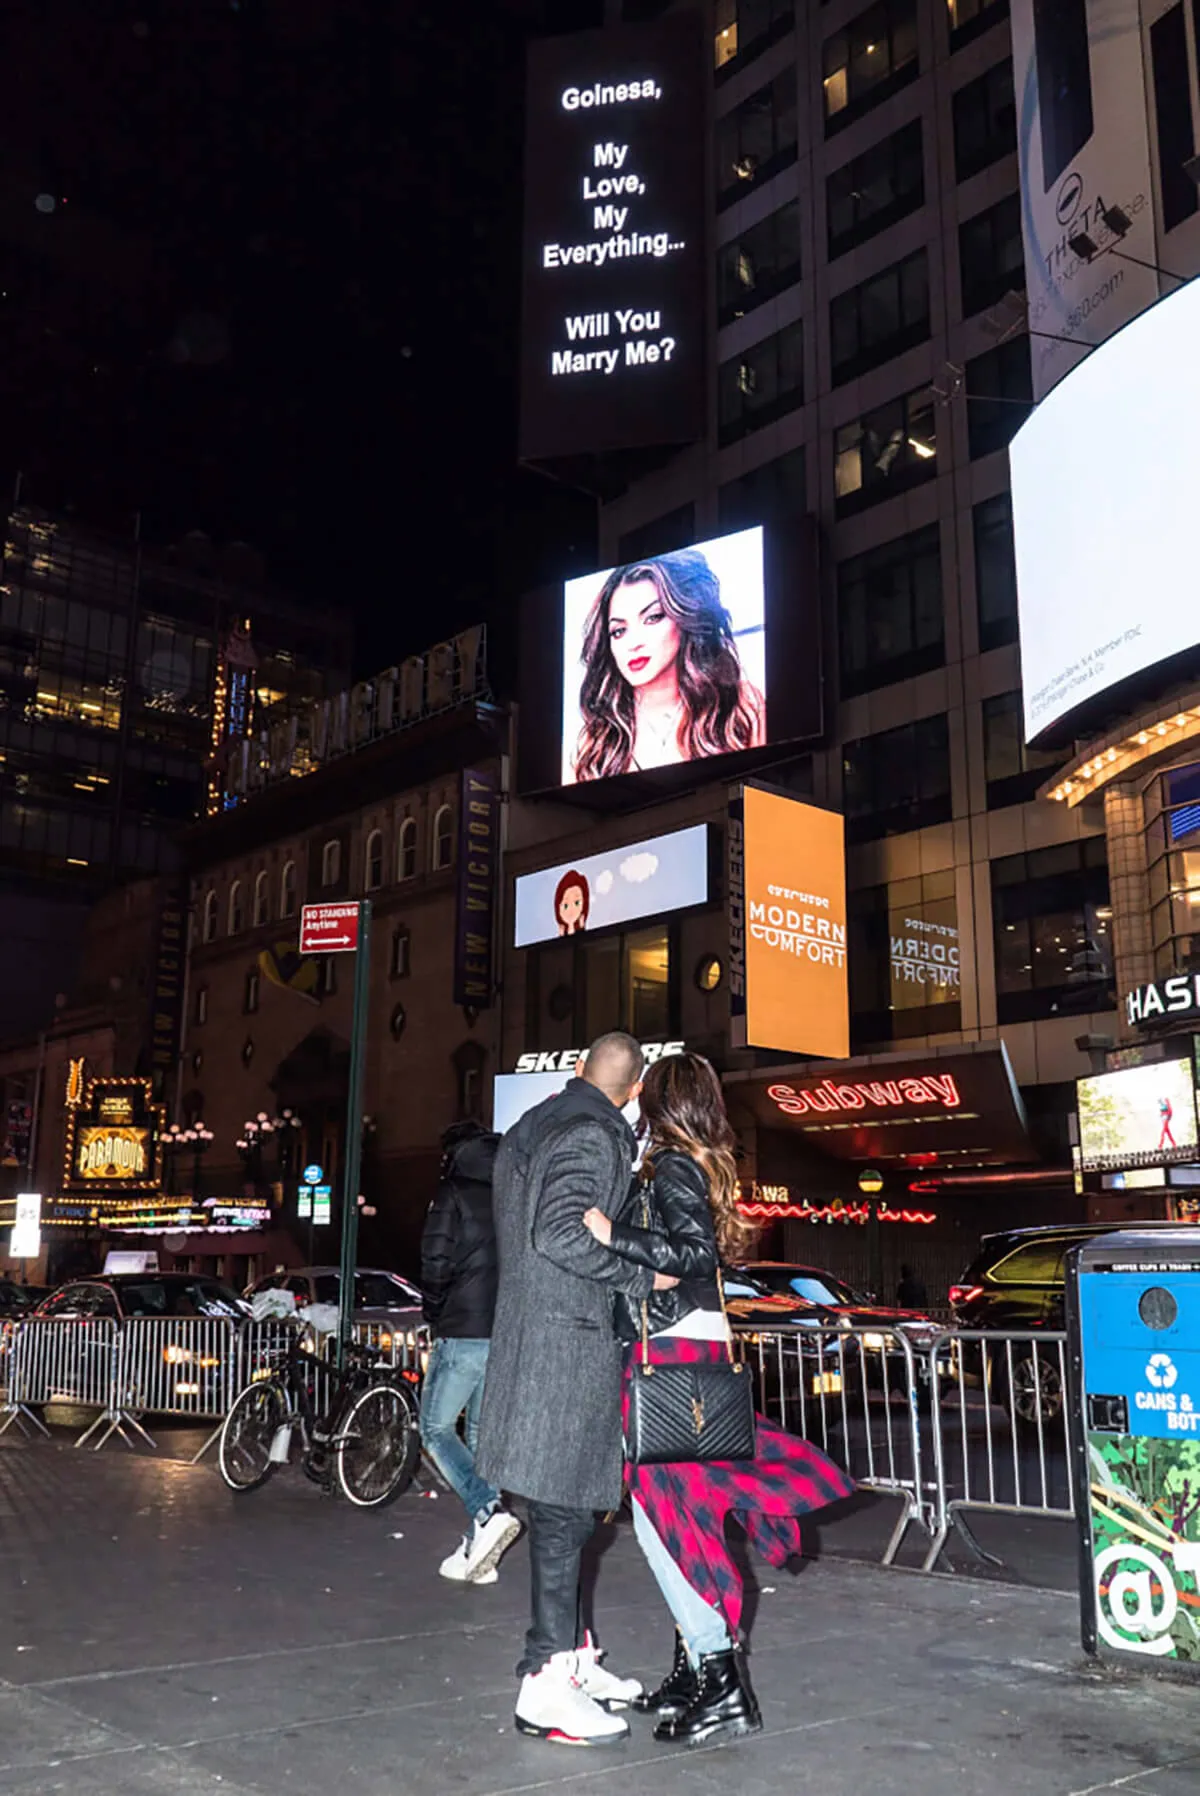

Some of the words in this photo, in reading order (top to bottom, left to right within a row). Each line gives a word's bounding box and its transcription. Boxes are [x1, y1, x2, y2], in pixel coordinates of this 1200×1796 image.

[594, 142, 628, 169] My
[583, 174, 646, 200] Love,
[594, 205, 628, 231] My
[543, 232, 685, 268] Everything...
[566, 312, 609, 340] Will
[615, 309, 660, 335] You
[552, 348, 617, 375] Marry
[625, 336, 675, 366] Me?
[465, 778, 491, 912] VICTORY
[306, 909, 318, 920] NO
[306, 920, 339, 932] Anytime
[750, 901, 845, 943] MODERN
[750, 926, 846, 968] COMFORT
[464, 931, 489, 998] NEW
[1126, 974, 1200, 1026] HAS
[515, 1041, 686, 1073] SKERS
[768, 1074, 961, 1114] Subway
[1135, 1391, 1177, 1411] CANS
[1180, 1393, 1193, 1412] &
